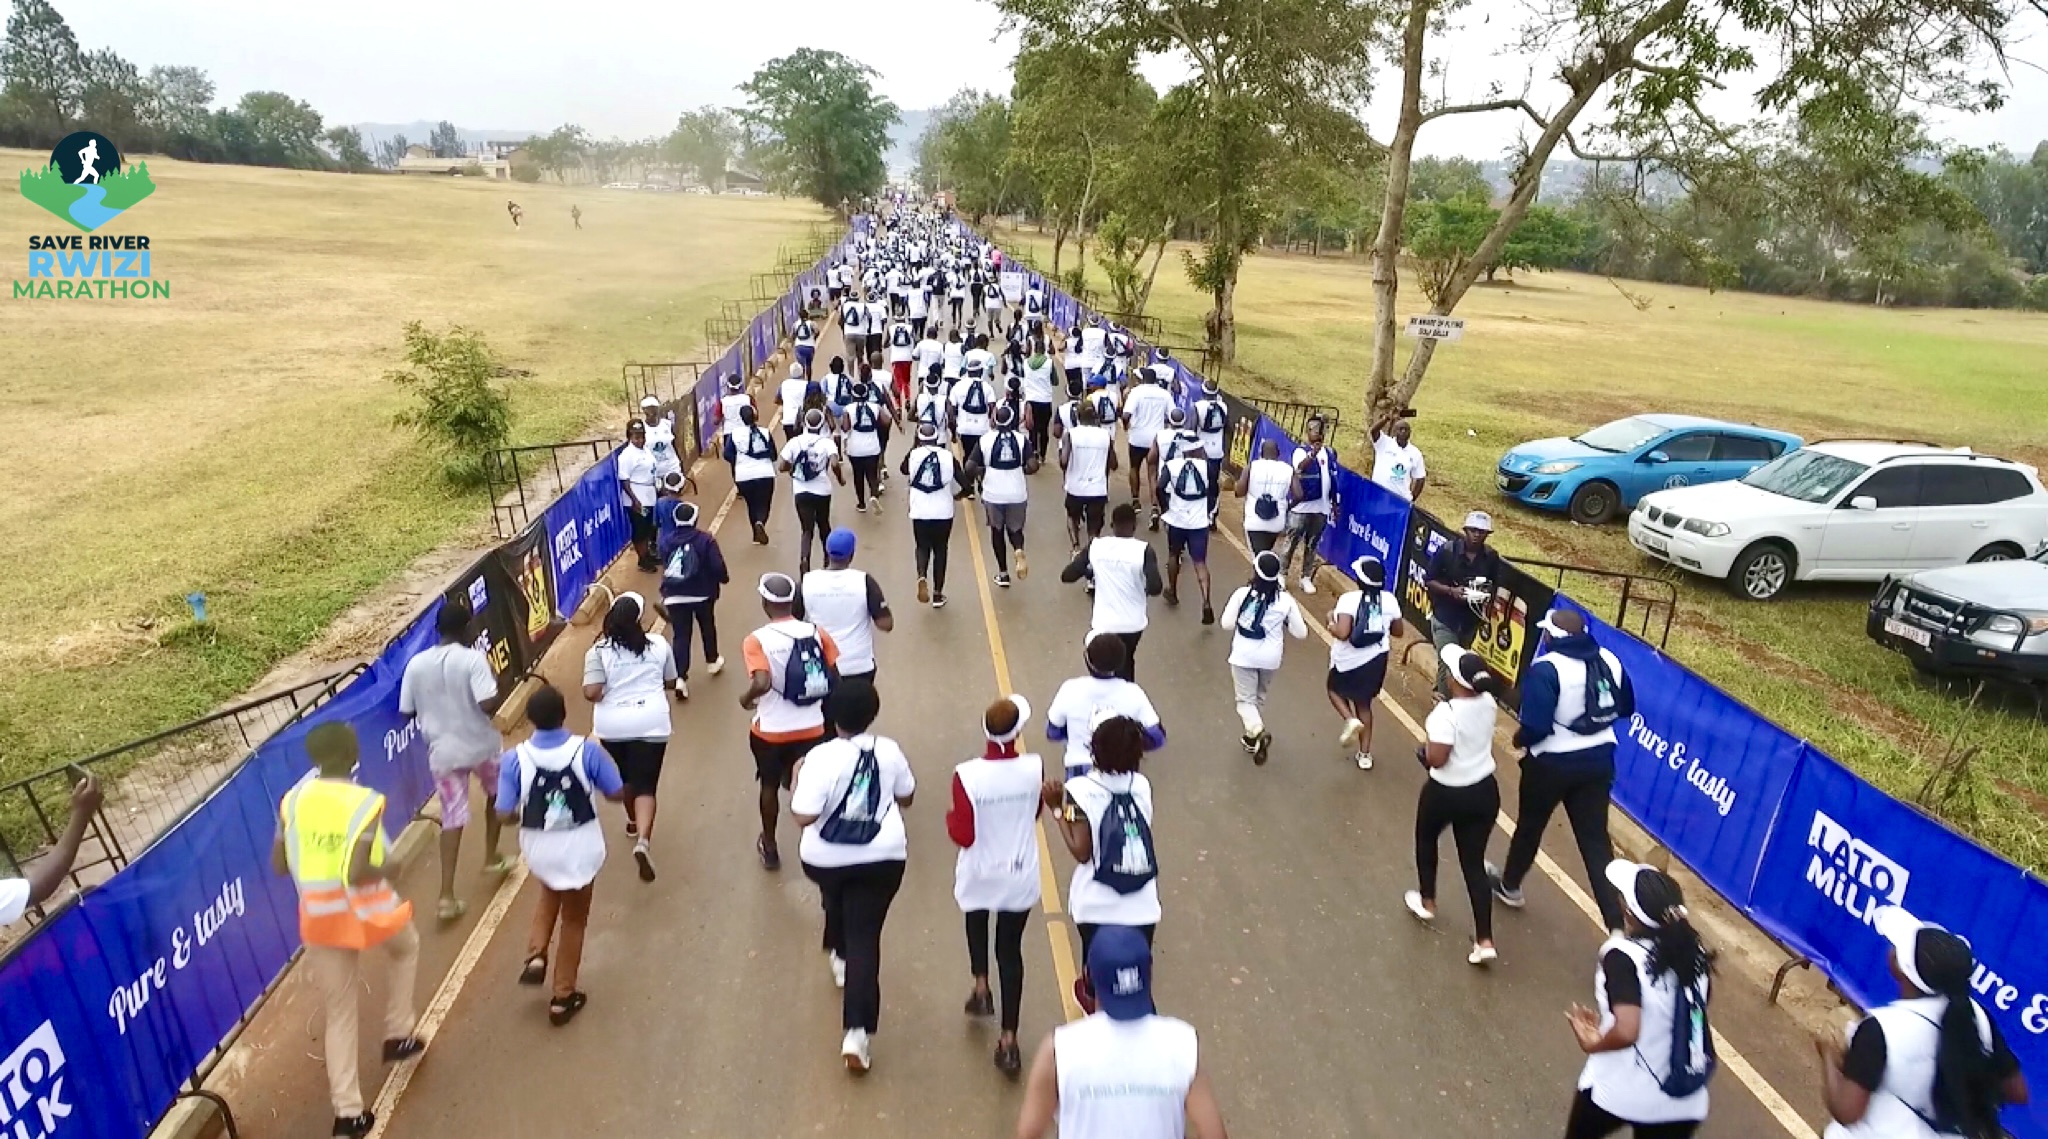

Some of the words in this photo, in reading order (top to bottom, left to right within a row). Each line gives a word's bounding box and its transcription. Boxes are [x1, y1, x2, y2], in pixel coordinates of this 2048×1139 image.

[1628, 712, 1668, 759] Pure
[1668, 742, 1687, 770] &
[1686, 758, 1736, 816] tasty
[1815, 820, 1899, 902] LATO
[109, 958, 166, 1035] Pure
[172, 927, 192, 970] &
[193, 877, 245, 946] tasty
[0, 1047, 51, 1118] TO
